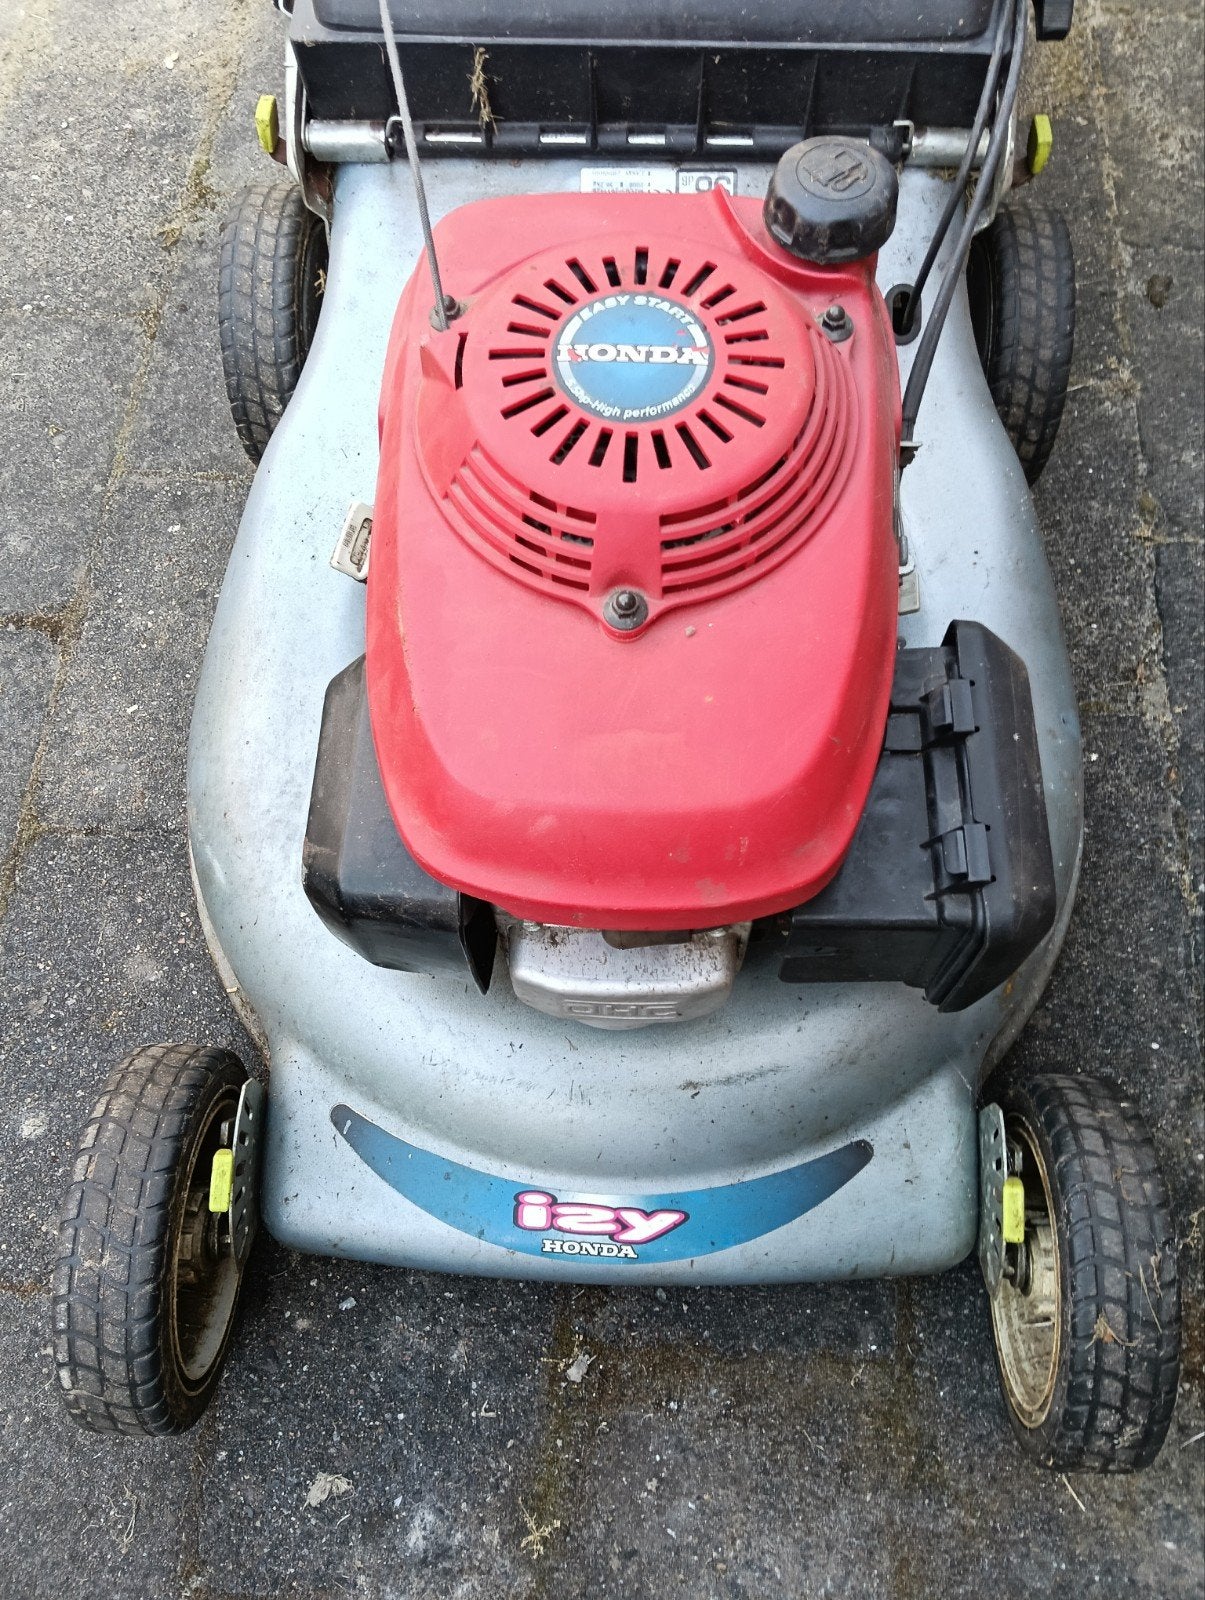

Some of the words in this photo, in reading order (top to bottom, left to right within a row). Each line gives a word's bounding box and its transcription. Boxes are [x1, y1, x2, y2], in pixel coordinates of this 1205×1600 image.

[579, 295, 630, 321] EASY
[633, 295, 696, 325] START
[556, 343, 710, 366] HONDA
[623, 383, 697, 420] performance
[513, 1190, 690, 1245] izy
[542, 1239, 638, 1259] HONDA
